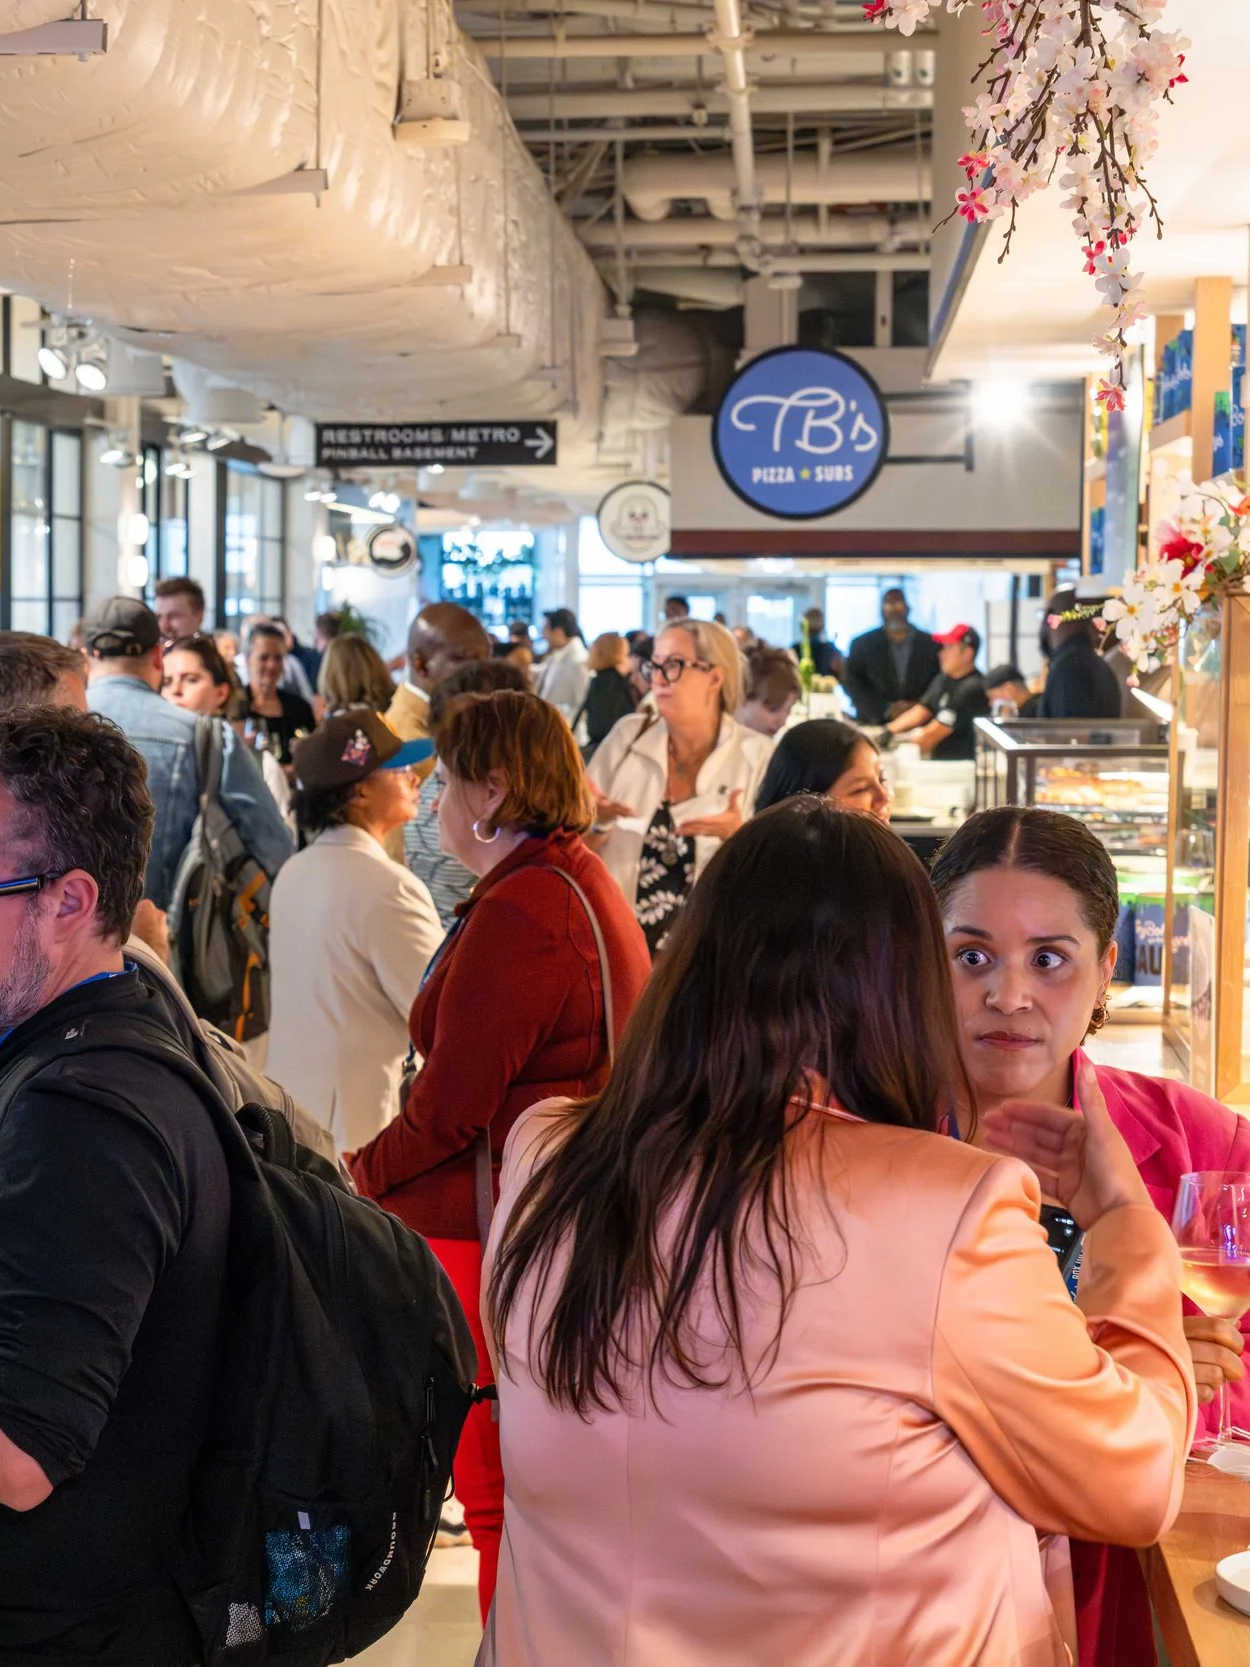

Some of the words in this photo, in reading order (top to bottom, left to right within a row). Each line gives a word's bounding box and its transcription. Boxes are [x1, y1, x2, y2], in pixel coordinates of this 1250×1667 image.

[730, 386, 878, 454] TB's
[322, 447, 388, 460] PINBALL
[392, 446, 478, 459] BASEMENT
[752, 466, 795, 483] PIZZA
[814, 465, 854, 482] SUBS
